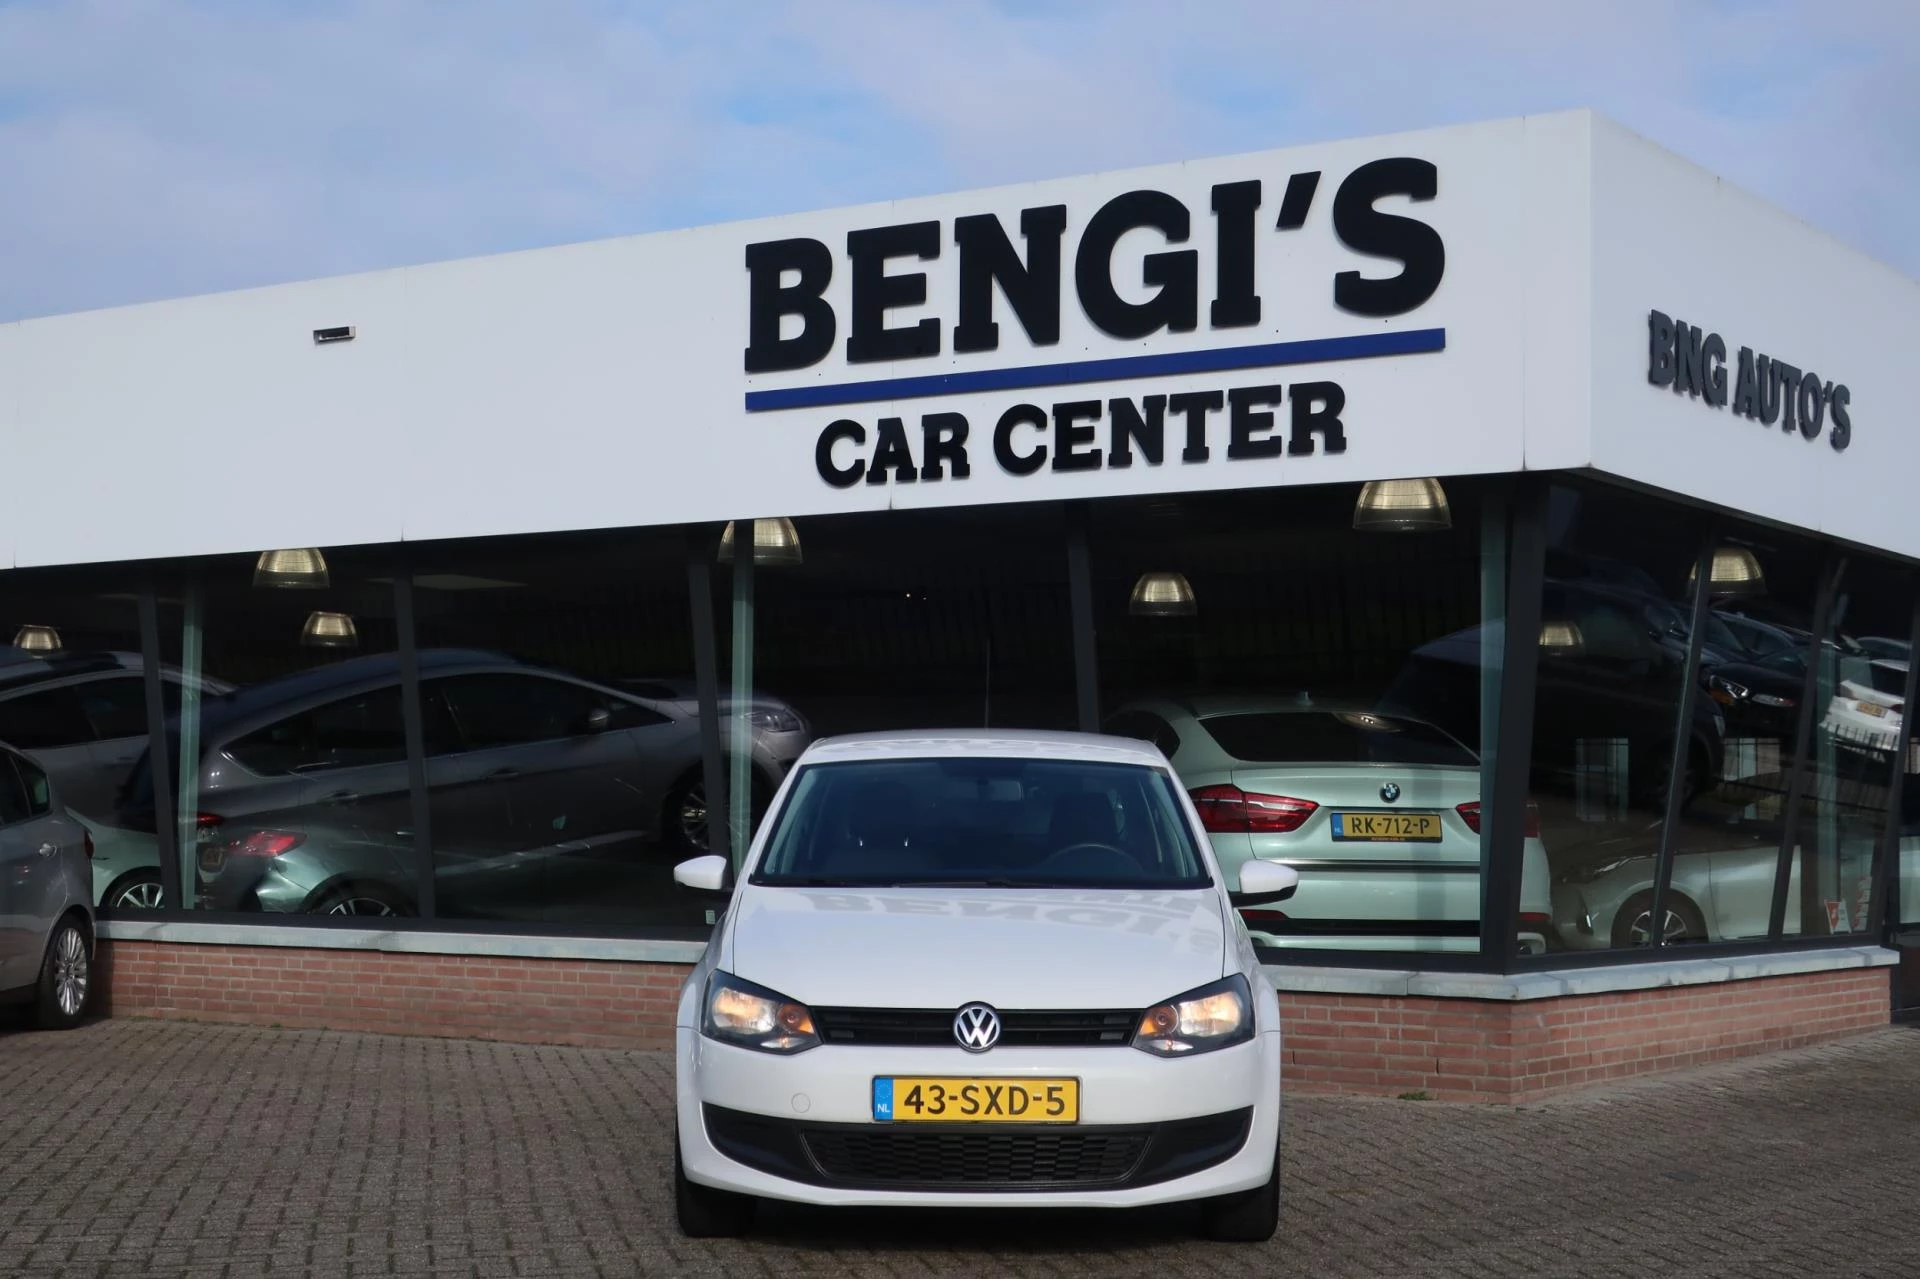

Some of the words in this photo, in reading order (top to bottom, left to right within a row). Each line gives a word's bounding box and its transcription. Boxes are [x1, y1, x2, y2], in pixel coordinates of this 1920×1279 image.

[744, 156, 1446, 374] BENGI'S
[1648, 309, 1729, 408] BNG
[1732, 345, 1852, 451] AUTO'S
[814, 411, 971, 487] CAR
[992, 380, 1348, 476] CENTER
[1351, 816, 1430, 834] RK-712-P
[876, 1104, 891, 1114] NL
[903, 1083, 1066, 1116] 43-SXD-5
